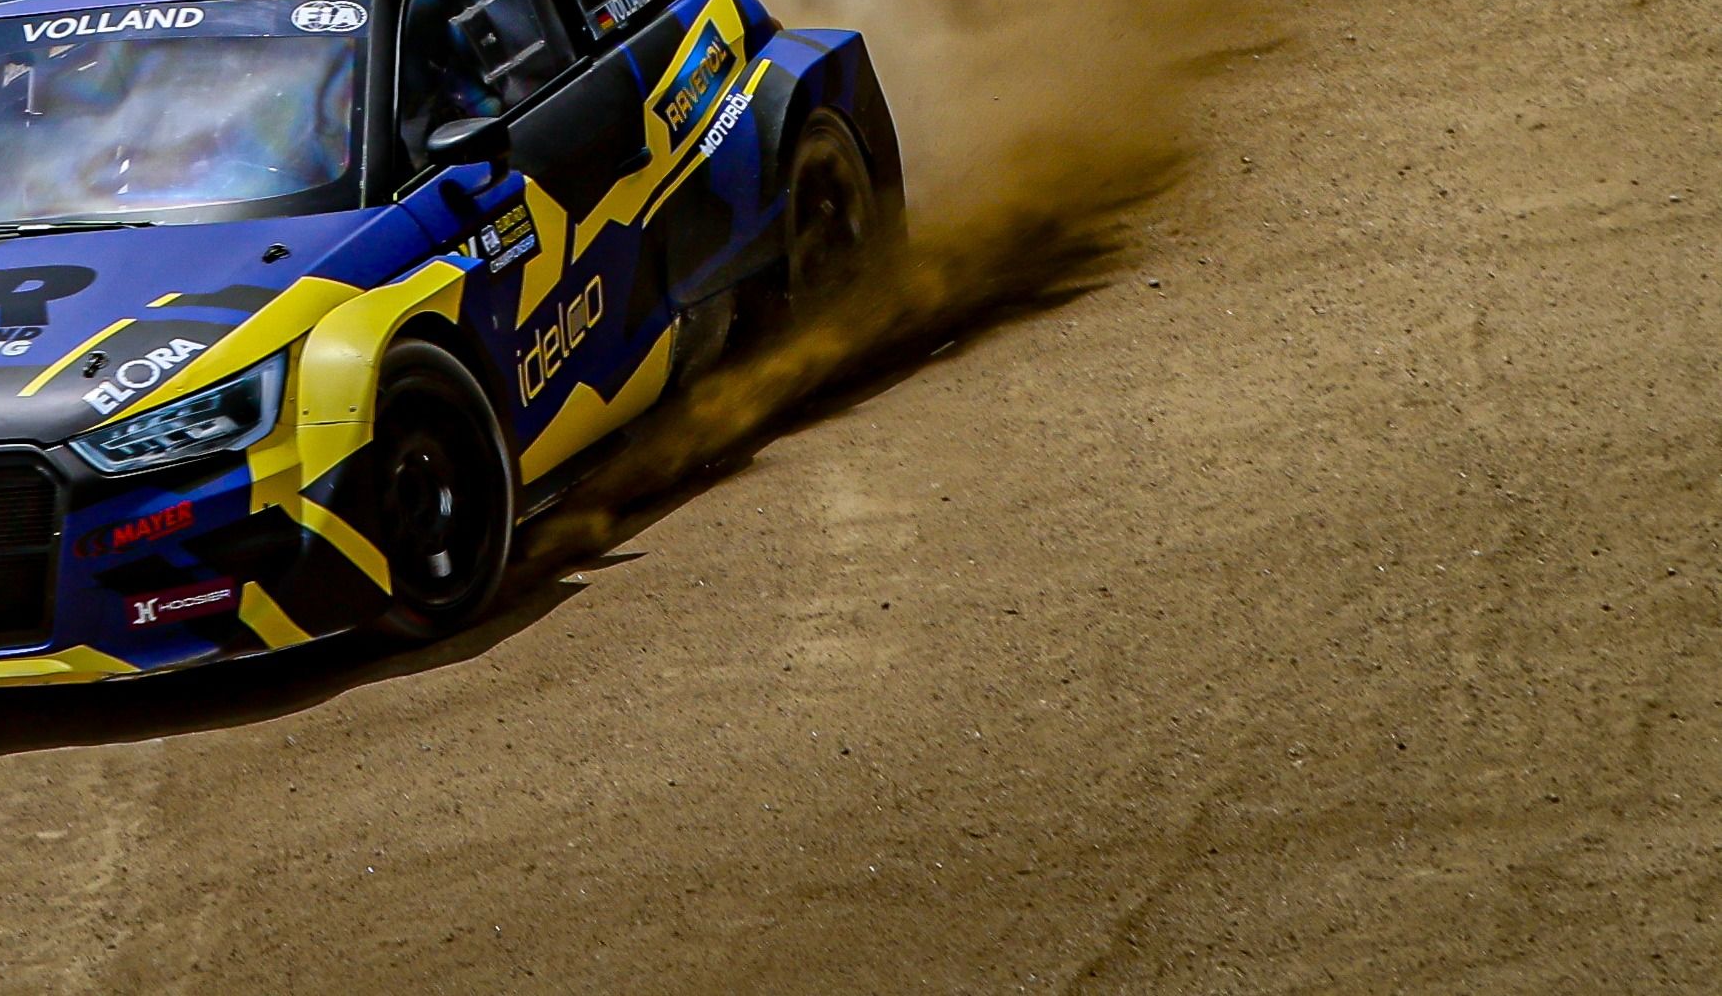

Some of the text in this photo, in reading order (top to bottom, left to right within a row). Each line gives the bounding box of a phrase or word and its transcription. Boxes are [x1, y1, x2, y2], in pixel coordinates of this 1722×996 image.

[22, 7, 204, 43] VOLLAND
[665, 36, 727, 132] RAVENOL
[699, 92, 753, 158] MOTORÖL
[515, 275, 604, 408] idelco
[82, 338, 208, 415] ELORA
[112, 500, 193, 547] MAYER
[159, 589, 231, 612] HOOSIER
